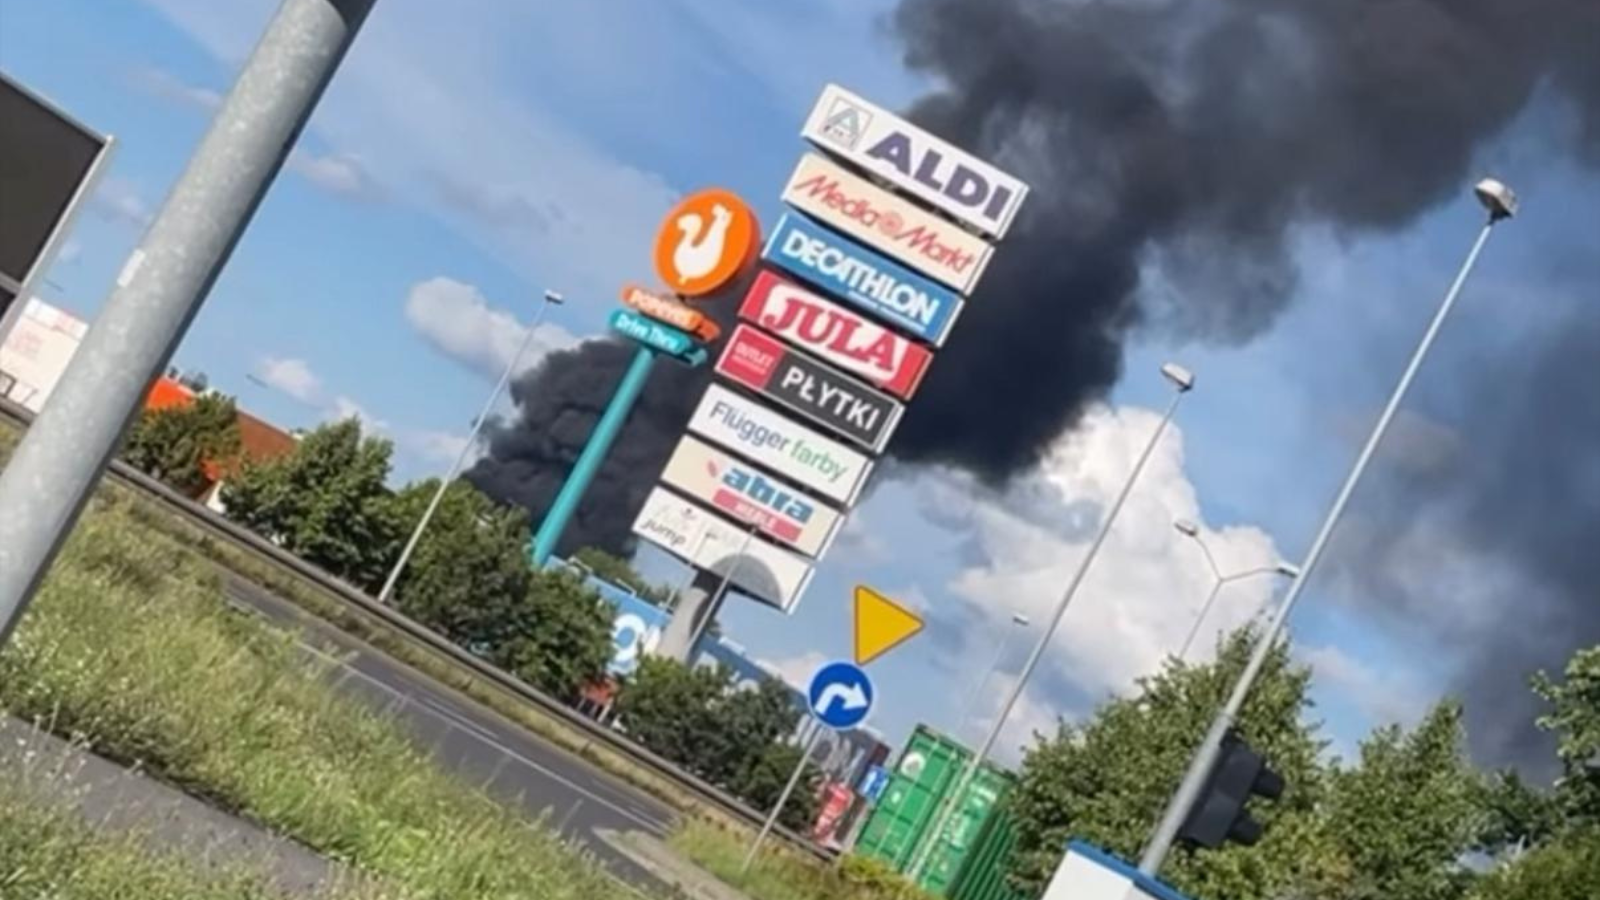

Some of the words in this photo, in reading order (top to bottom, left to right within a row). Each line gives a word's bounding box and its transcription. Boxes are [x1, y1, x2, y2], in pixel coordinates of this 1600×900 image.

[865, 130, 1013, 223] ALDI
[793, 174, 881, 228] Media
[895, 225, 975, 275] Markt
[780, 229, 940, 326] DECATHLON
[762, 297, 898, 372] JULA
[781, 366, 881, 432] PŁYTKI
[709, 400, 790, 451] Flügger
[788, 439, 849, 483] farby
[722, 466, 815, 525] abra
